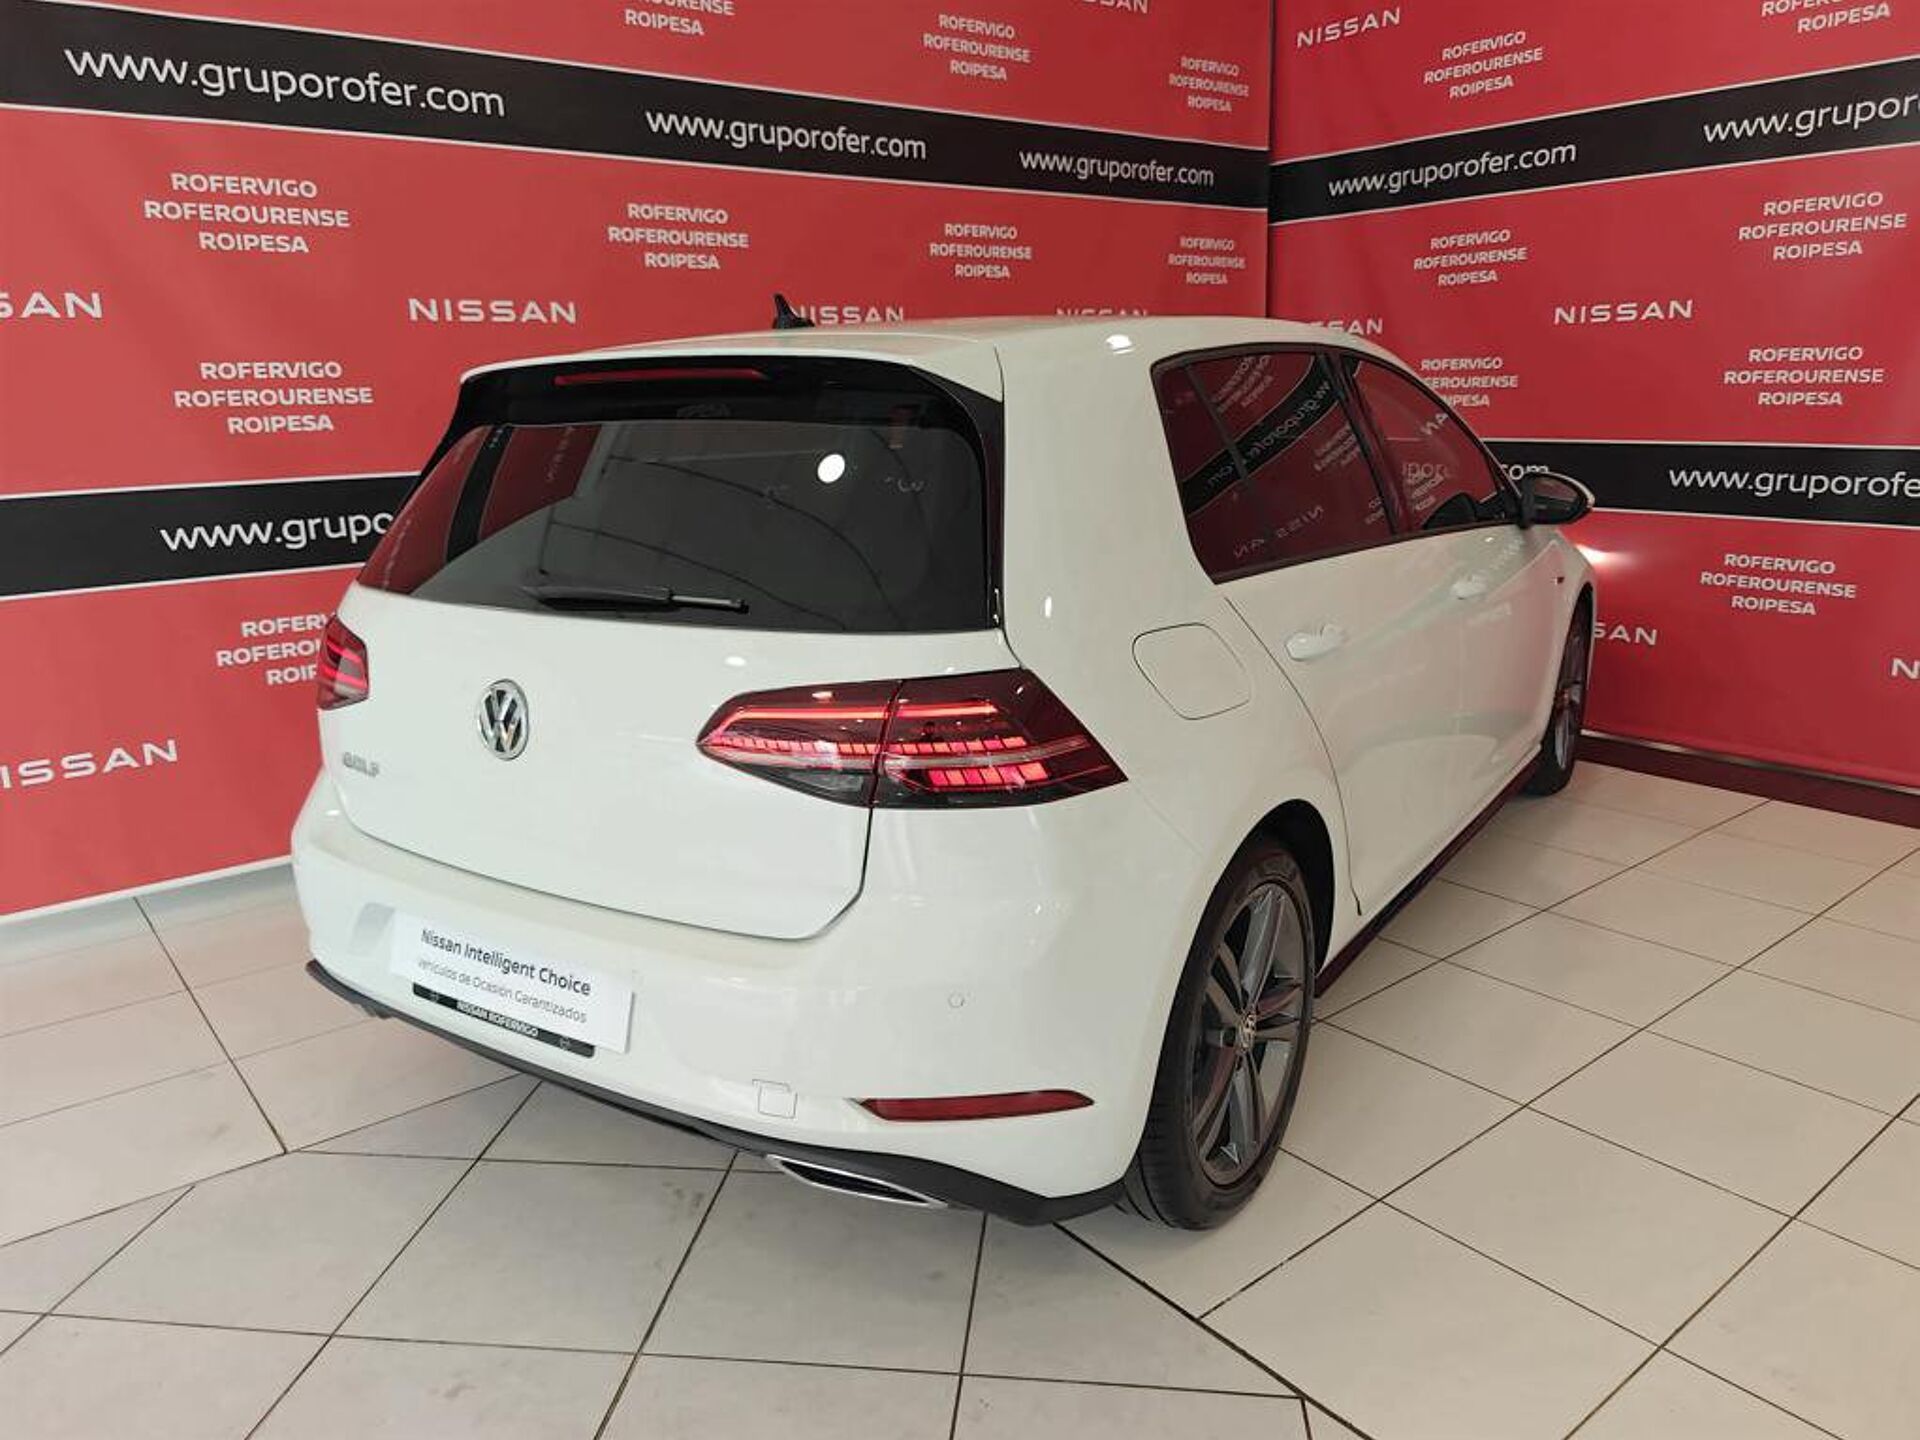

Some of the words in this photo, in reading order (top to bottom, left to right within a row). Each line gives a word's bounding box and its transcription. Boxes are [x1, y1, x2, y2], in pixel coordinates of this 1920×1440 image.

[625, 8, 705, 36] ROIPESA
[938, 14, 1015, 40] ROFERVIGO
[1297, 7, 1400, 48] NISSAN
[1797, 2, 1891, 33] ROIPESA
[923, 33, 1030, 63] ROFEROURENSE
[1441, 30, 1526, 61] ROFERVIGO
[949, 59, 1007, 81] ROIPESA
[1180, 56, 1240, 77] ROFERVIGO
[1423, 47, 1543, 84] ROFEROURENSE
[64, 49, 505, 117] www.gruporofer.com
[1169, 73, 1249, 97] ROFEROURENSE
[1449, 75, 1514, 99] ROIPESA
[1187, 94, 1232, 112] ROIPESA
[1703, 93, 1920, 143] www.grupor
[645, 111, 926, 159] www.gruporofer.com
[1018, 151, 1214, 186] www.gruporofer.com
[1328, 144, 1577, 197] www.gruporofer.com
[170, 172, 318, 198] ROFERVIGO
[143, 200, 350, 228] ROFEROURENSE
[627, 202, 729, 224] ROFERVIGO
[1763, 191, 1884, 216] ROFERVIGO
[607, 226, 749, 248] ROFEROURENSE
[944, 223, 1018, 240] ROFERVIGO
[1738, 212, 1907, 240] ROFEROURENSE
[198, 231, 310, 253] ROIPESA
[1180, 236, 1235, 252] ROFERVIGO
[1430, 228, 1511, 250] ROFERVIGO
[1773, 240, 1863, 260] ROIPESA
[644, 251, 721, 270] ROIPESA
[929, 242, 1032, 260] ROFEROURENSE
[1168, 253, 1246, 269] ROFEROURENSE
[1413, 246, 1528, 270] ROFEROURENSE
[954, 263, 1011, 279] ROIPESA
[1185, 271, 1228, 285] ROIPESA
[1438, 269, 1498, 286] ROIPESA
[408, 298, 576, 324] NISSAN
[1554, 299, 1693, 325] NISSAN
[1420, 356, 1504, 371] ROFERVIGO
[1748, 346, 1863, 363] ROFERVIGO
[200, 361, 342, 380] ROFERVIGO
[1723, 368, 1884, 385] ROFEROURENSE
[174, 387, 373, 408] ROFEROURENSE
[1757, 391, 1843, 406] ROIPESA
[227, 414, 334, 435] ROIPESA
[1724, 553, 1836, 575] ROFERVIGO
[1700, 571, 1857, 599] ROFEROURENSE
[1731, 595, 1816, 616] ROIPESA
[215, 639, 322, 667] ROFERO
[420, 928, 463, 956] Nissan
[464, 944, 536, 980] Intelligent
[538, 967, 592, 997] Choice
[458, 971, 473, 986] de
